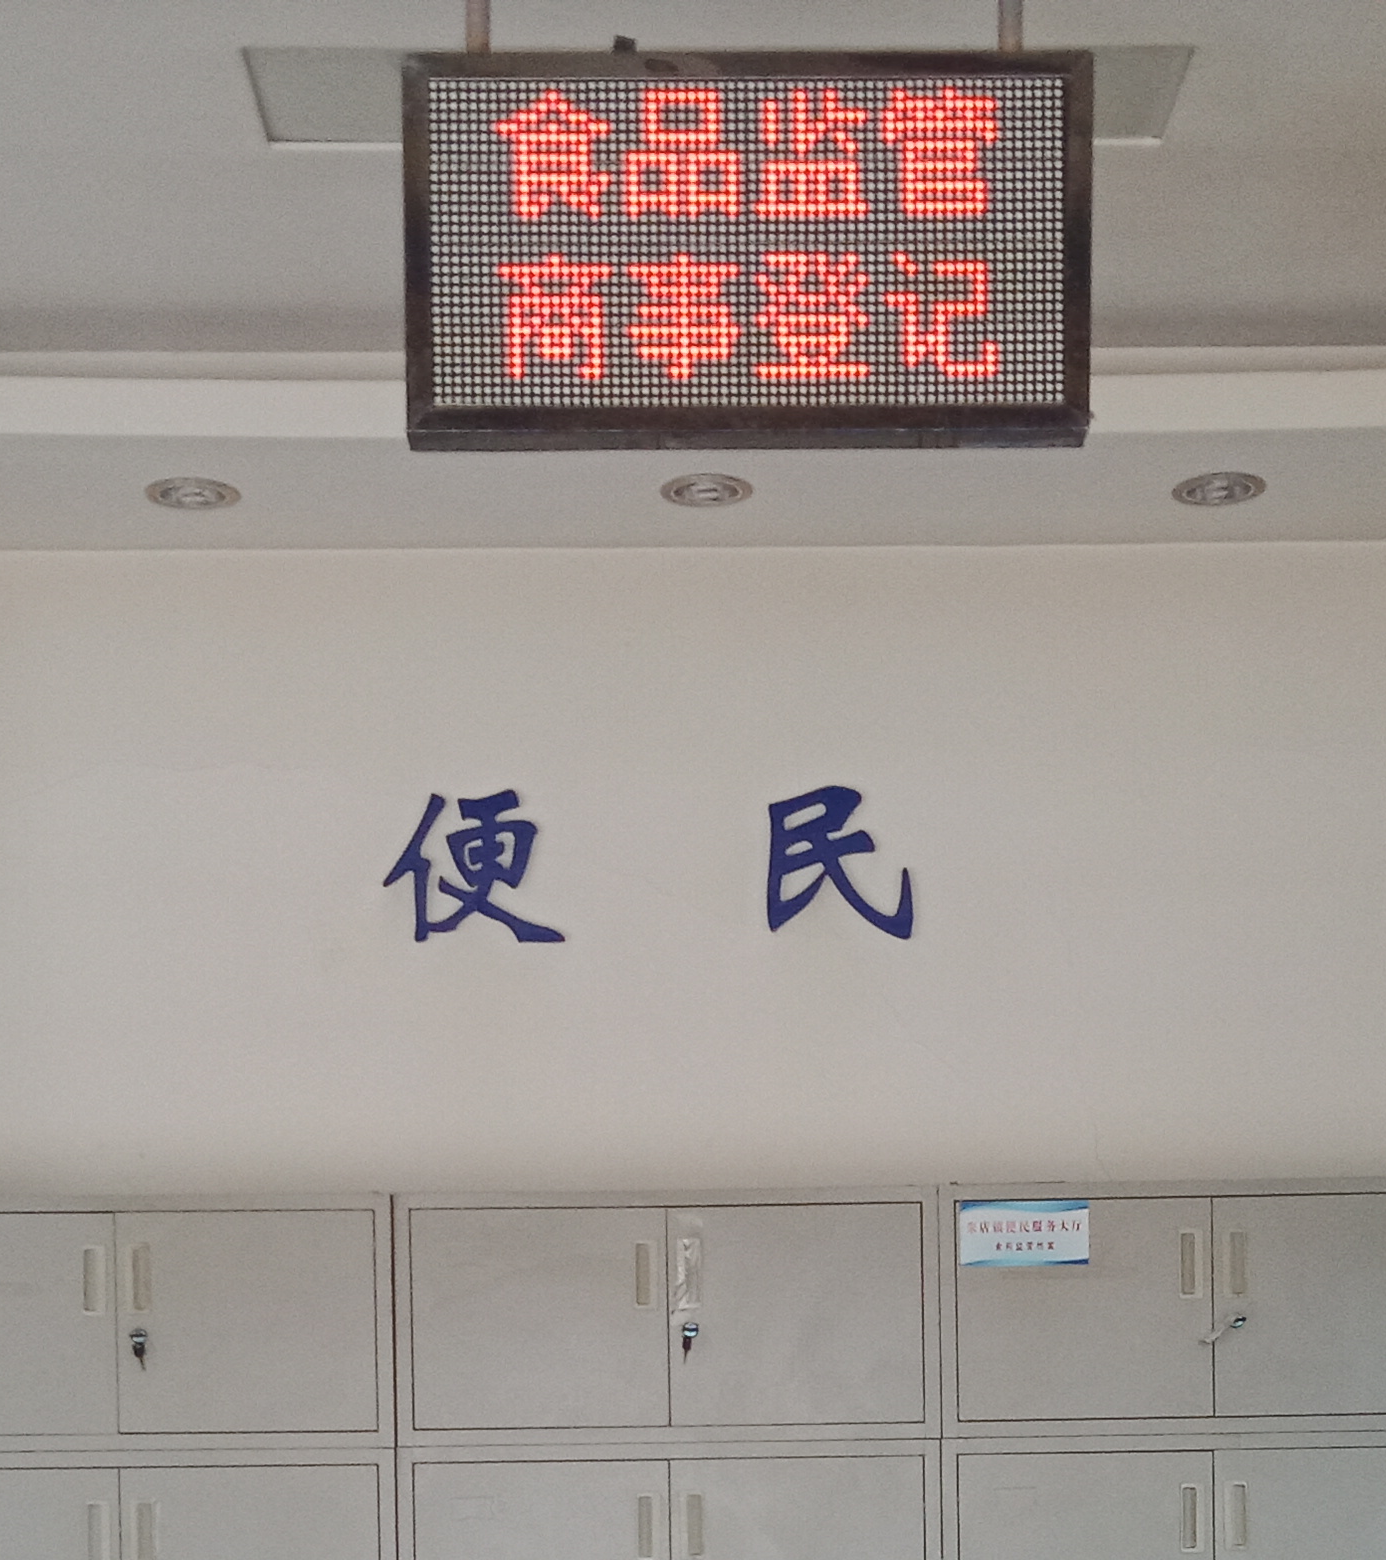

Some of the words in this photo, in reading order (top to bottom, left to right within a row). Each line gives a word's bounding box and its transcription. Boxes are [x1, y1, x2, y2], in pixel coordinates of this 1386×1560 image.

[494, 86, 999, 219] 食品监管
[497, 250, 1000, 380] 商事登记
